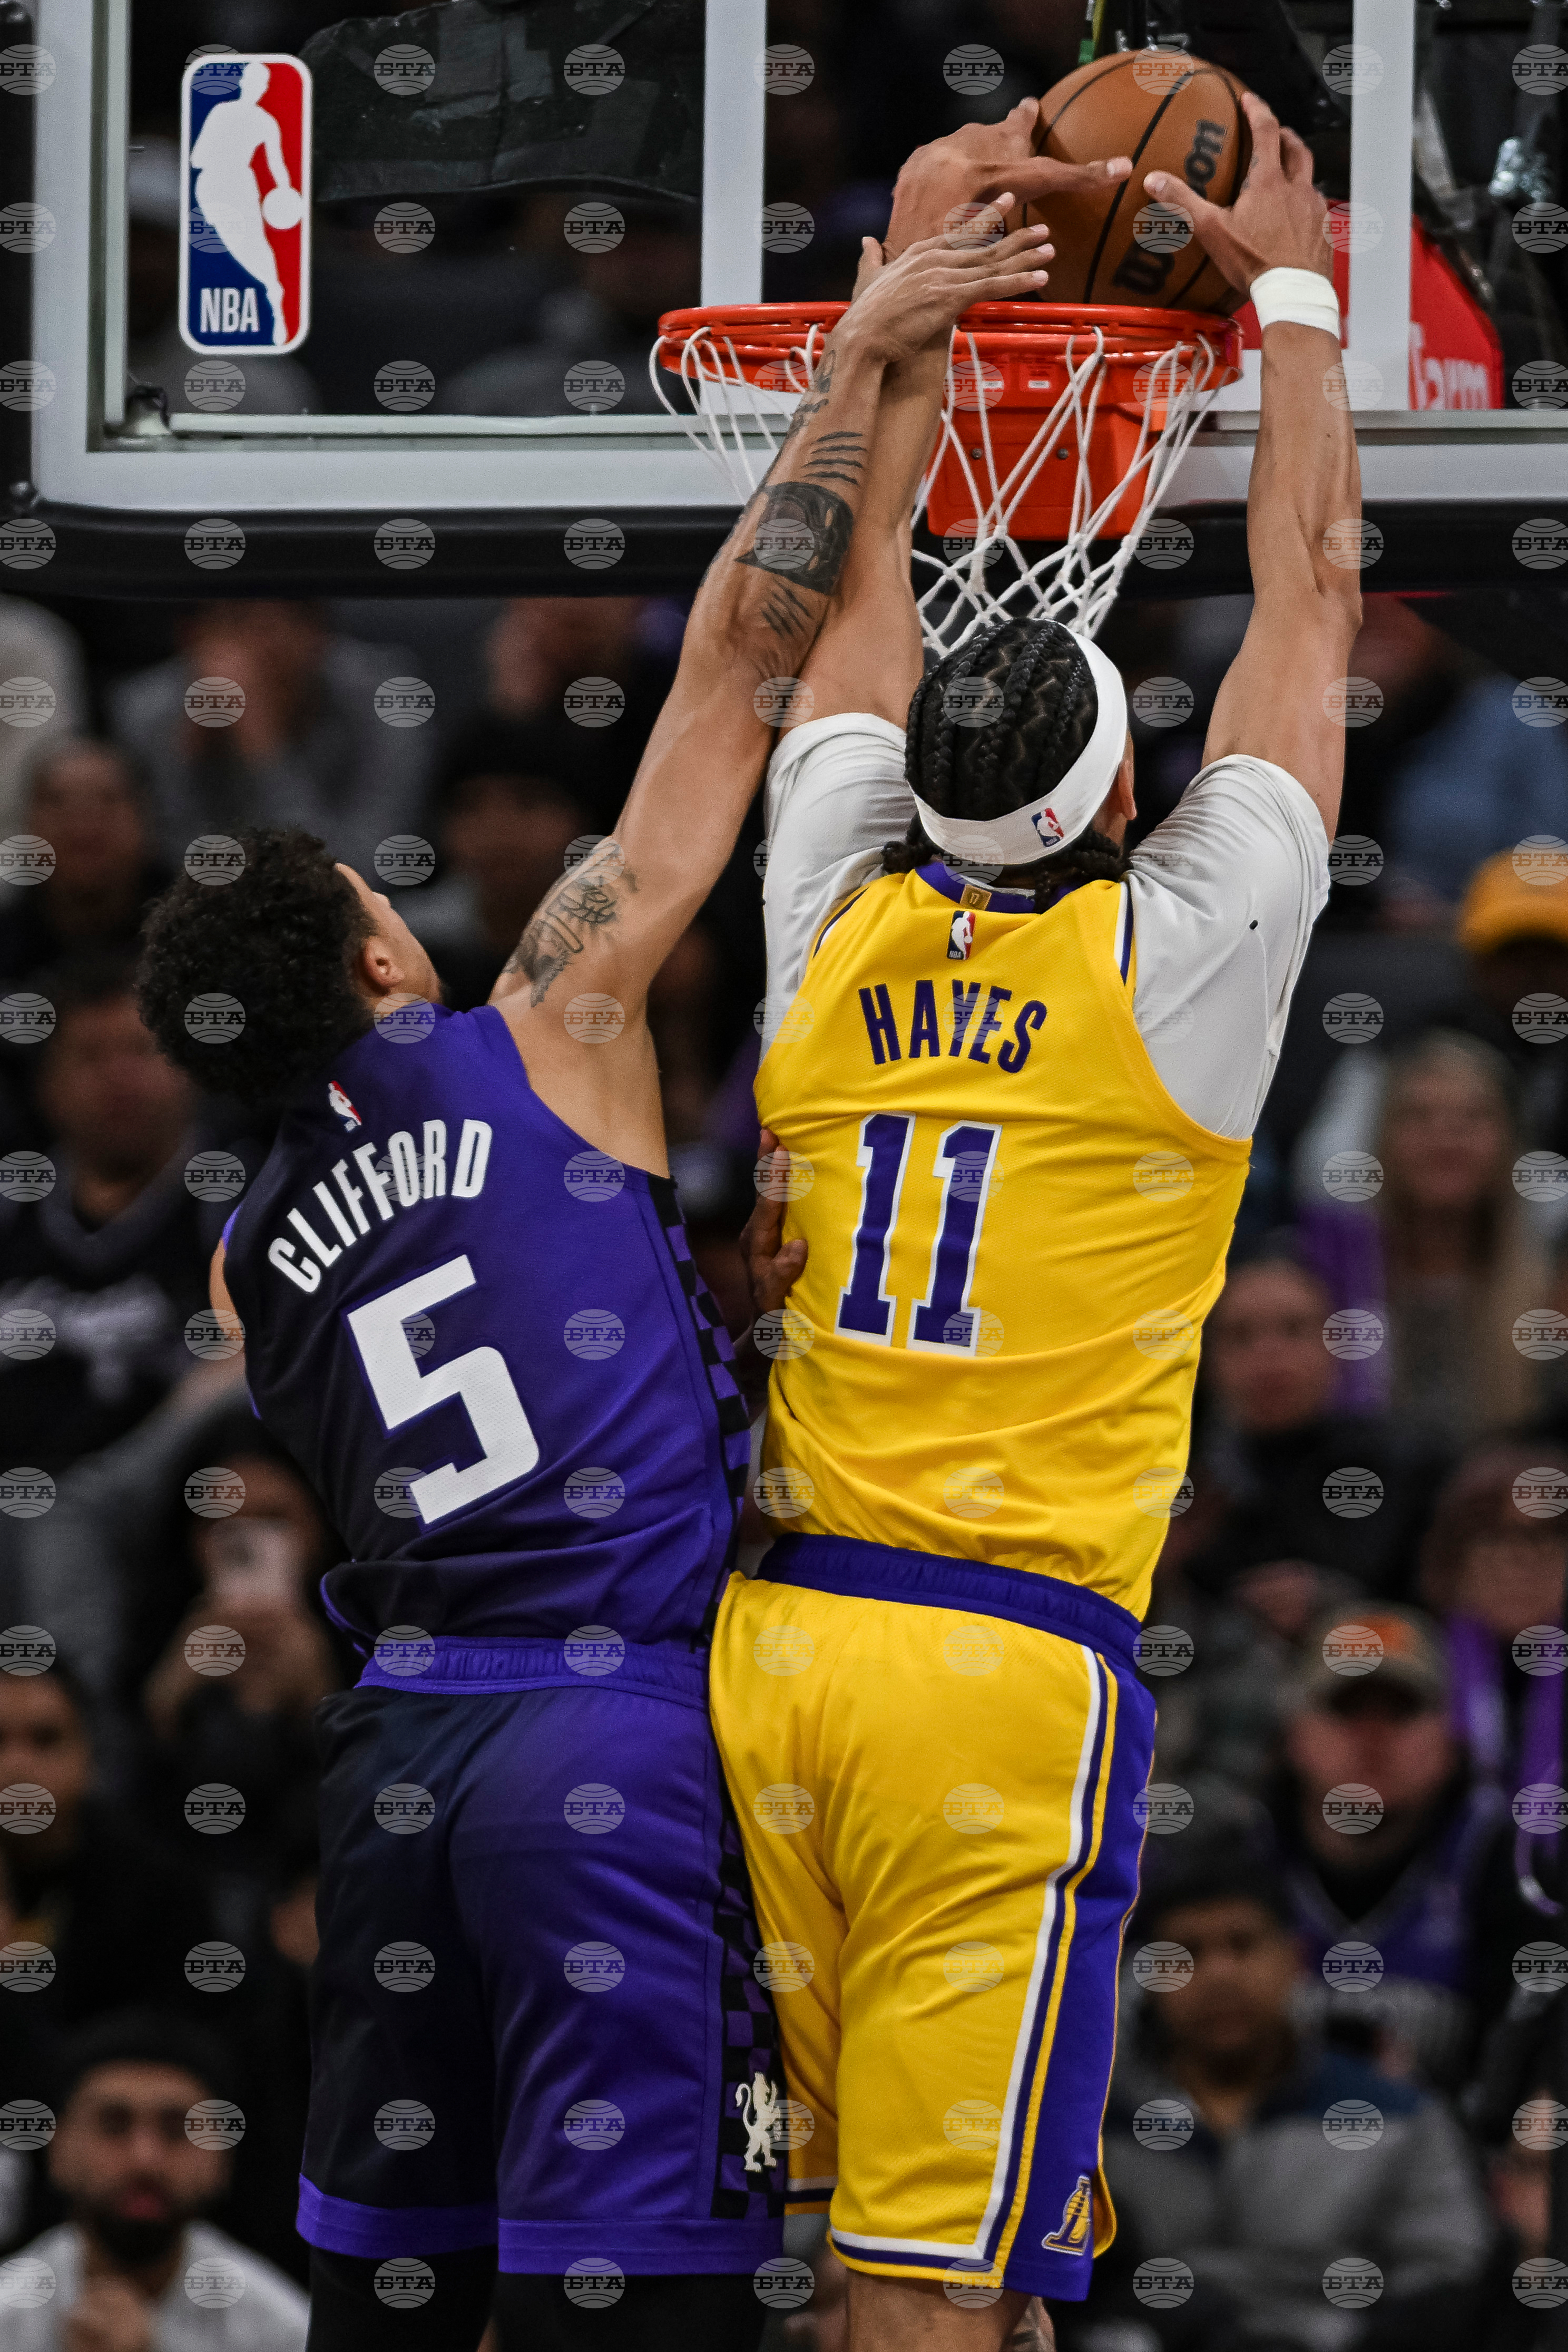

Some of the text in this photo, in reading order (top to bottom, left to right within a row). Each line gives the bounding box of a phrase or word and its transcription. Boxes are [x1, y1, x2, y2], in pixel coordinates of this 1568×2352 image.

[200, 287, 259, 333] NBA
[858, 980, 1047, 1073] HAYES
[268, 1119, 493, 1294] CLIFFORD
[834, 1110, 1002, 1356] 11
[347, 1254, 540, 1525] 5
